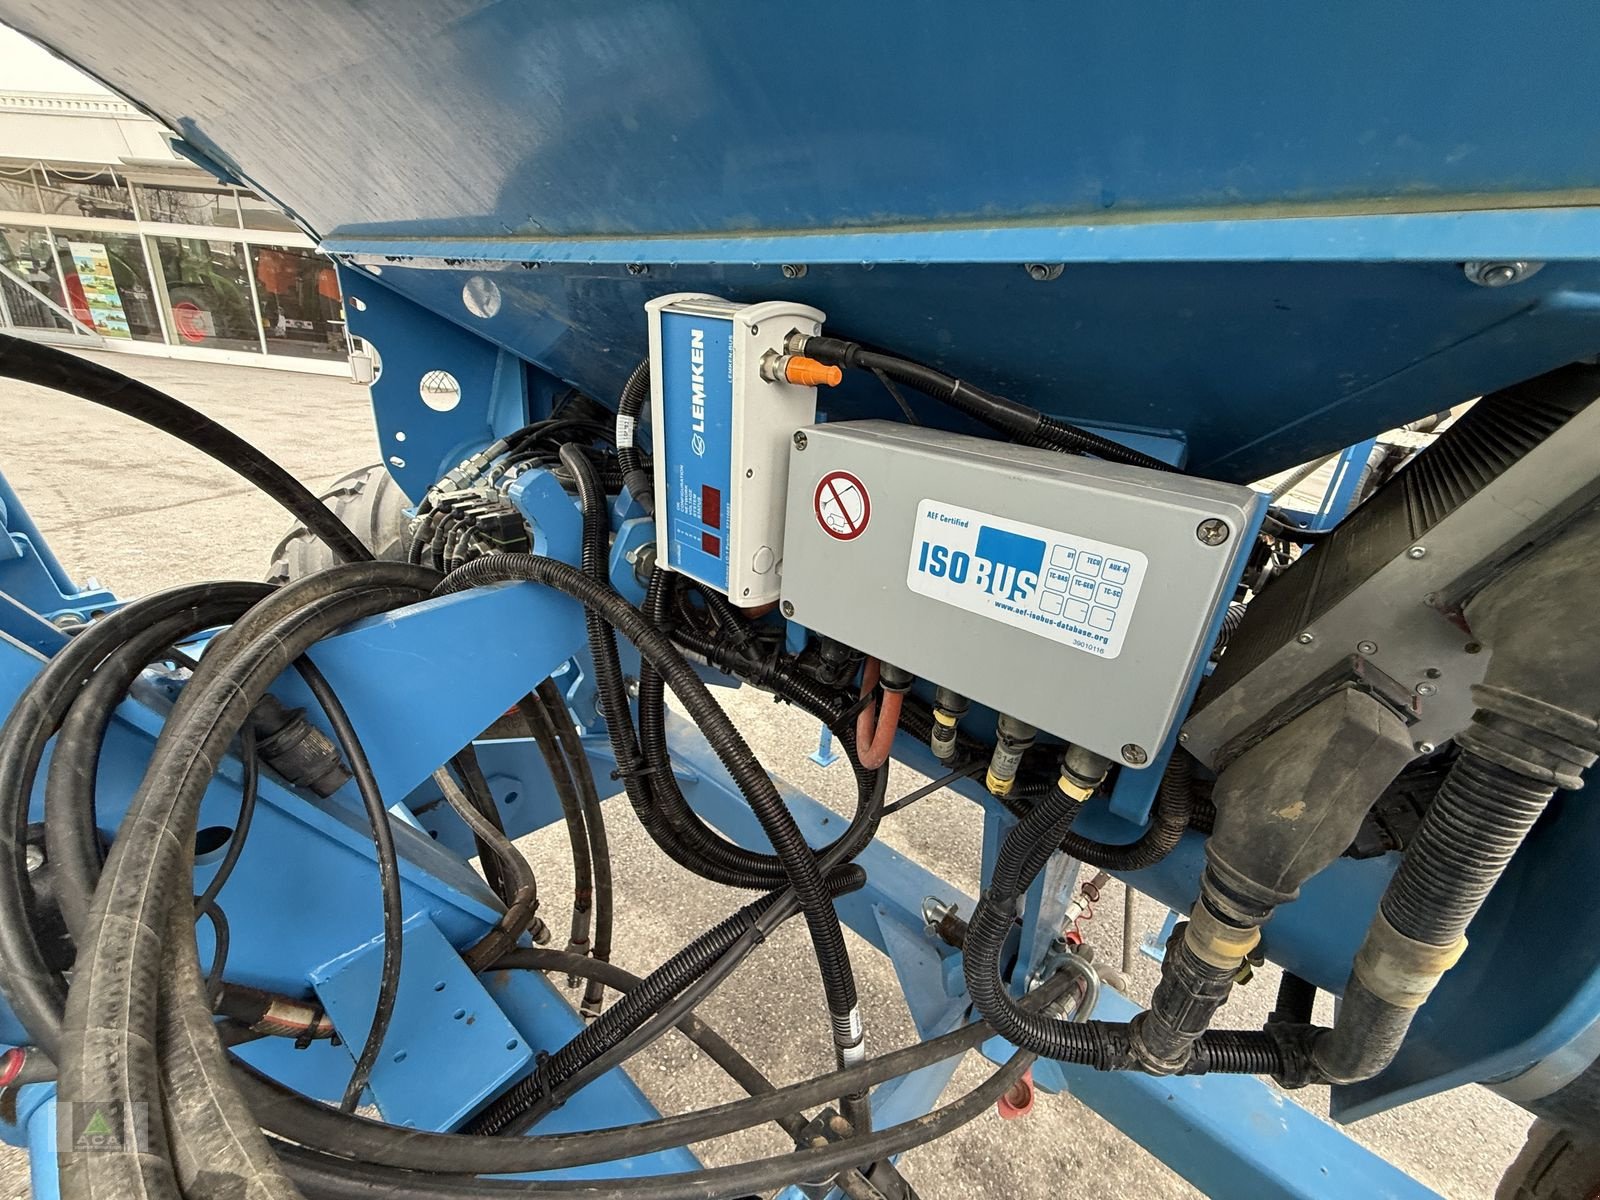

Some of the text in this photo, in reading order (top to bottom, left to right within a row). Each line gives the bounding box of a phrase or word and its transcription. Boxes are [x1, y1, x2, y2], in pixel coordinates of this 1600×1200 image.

[691, 329, 706, 433] LEMKEN
[927, 511, 969, 528] AEF Certified
[1104, 588, 1121, 598] TC-SC
[995, 601, 1109, 645] www.aef-isobus-database.org
[1072, 639, 1105, 654] 39010116
